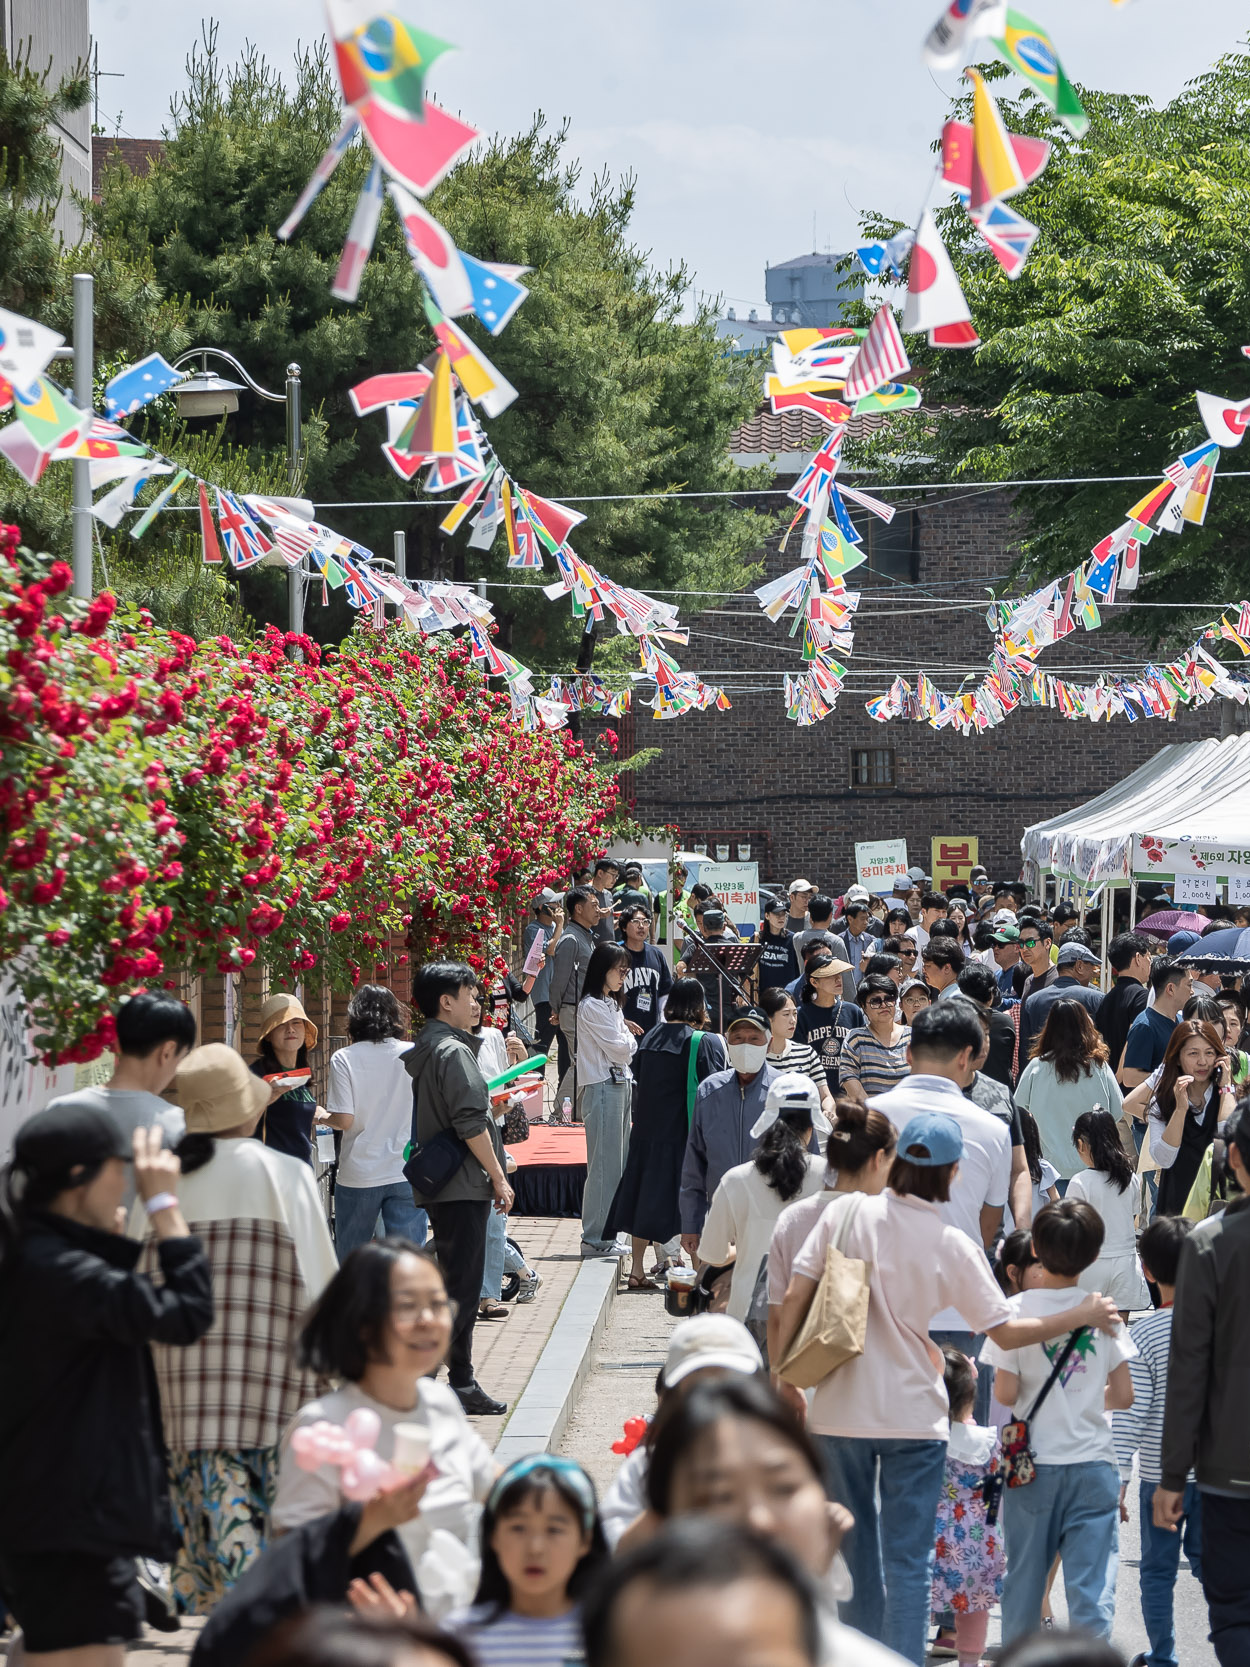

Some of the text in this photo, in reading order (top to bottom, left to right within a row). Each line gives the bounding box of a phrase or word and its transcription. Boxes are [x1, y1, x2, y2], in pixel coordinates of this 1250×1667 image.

[869, 856, 896, 865] 자양3동
[1200, 852, 1225, 862] 제6회
[860, 864, 907, 878] 장미축제
[714, 881, 745, 891] 자양3동
[712, 891, 757, 905] 미축제
[1182, 891, 1211, 900] 2,000원
[761, 951, 777, 960] SA
[623, 967, 660, 994] NAVY
[808, 1026, 832, 1044] ARPE
[821, 1056, 840, 1066] EGEN
